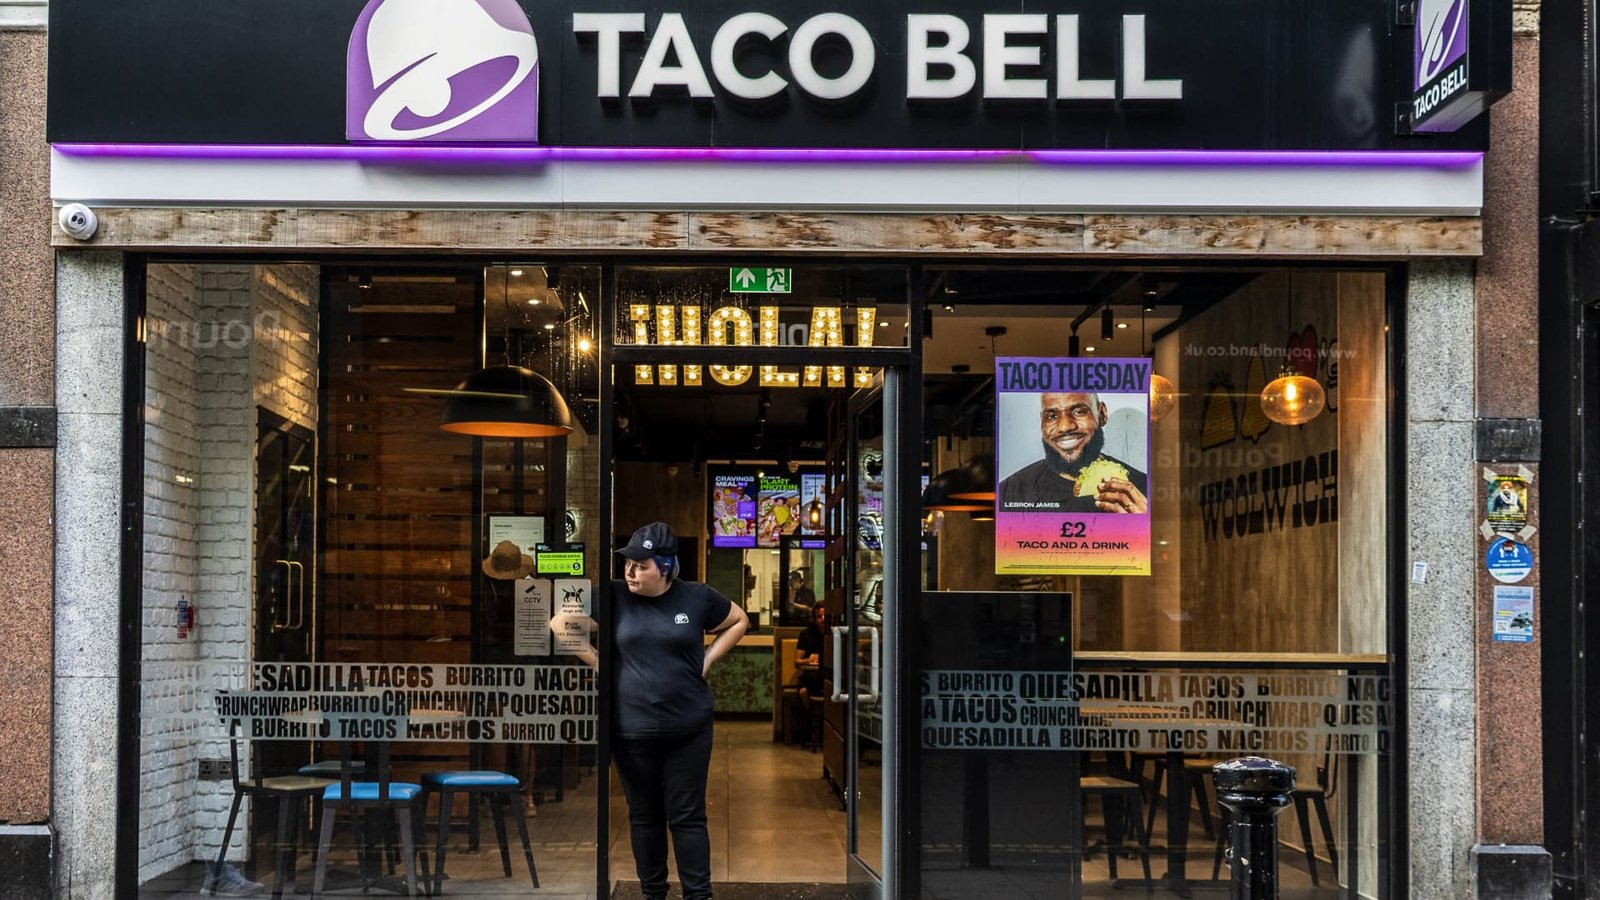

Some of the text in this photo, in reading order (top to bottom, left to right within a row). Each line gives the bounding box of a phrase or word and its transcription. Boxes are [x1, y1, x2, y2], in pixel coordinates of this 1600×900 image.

[573, 12, 1183, 99] TACO BELL
[1413, 64, 1467, 119] TACO BELL
[999, 362, 1149, 391] TACO TUESDAY
[1200, 449, 1338, 544] WOOLWICH
[1060, 522, 1086, 538] £2
[1017, 541, 1129, 550] TACO AND A DRINK
[367, 665, 433, 687] TACOS
[446, 667, 525, 686] BURRITO
[938, 673, 1013, 692] BURRITO
[1019, 674, 1174, 703] QUESADILLA
[1179, 675, 1245, 698] TACOS
[1258, 676, 1339, 697] BURRITO
[1347, 677, 1390, 700] NAC
[309, 695, 379, 713] BURRITO
[382, 690, 509, 717] CRUNCHWRAP
[939, 694, 1017, 723] TACOS
[1192, 700, 1322, 727] CRUNCHWRAP
[1324, 703, 1390, 727] QUESA
[339, 719, 396, 738] TACOS
[407, 719, 495, 740] NACHOS
[502, 723, 555, 741] BURRITO
[560, 719, 598, 743] QU
[923, 727, 1051, 748] QUESADILLA
[1059, 728, 1140, 748] BURRITO
[1148, 729, 1208, 749] TACOS
[1218, 729, 1308, 750] NACHOS
